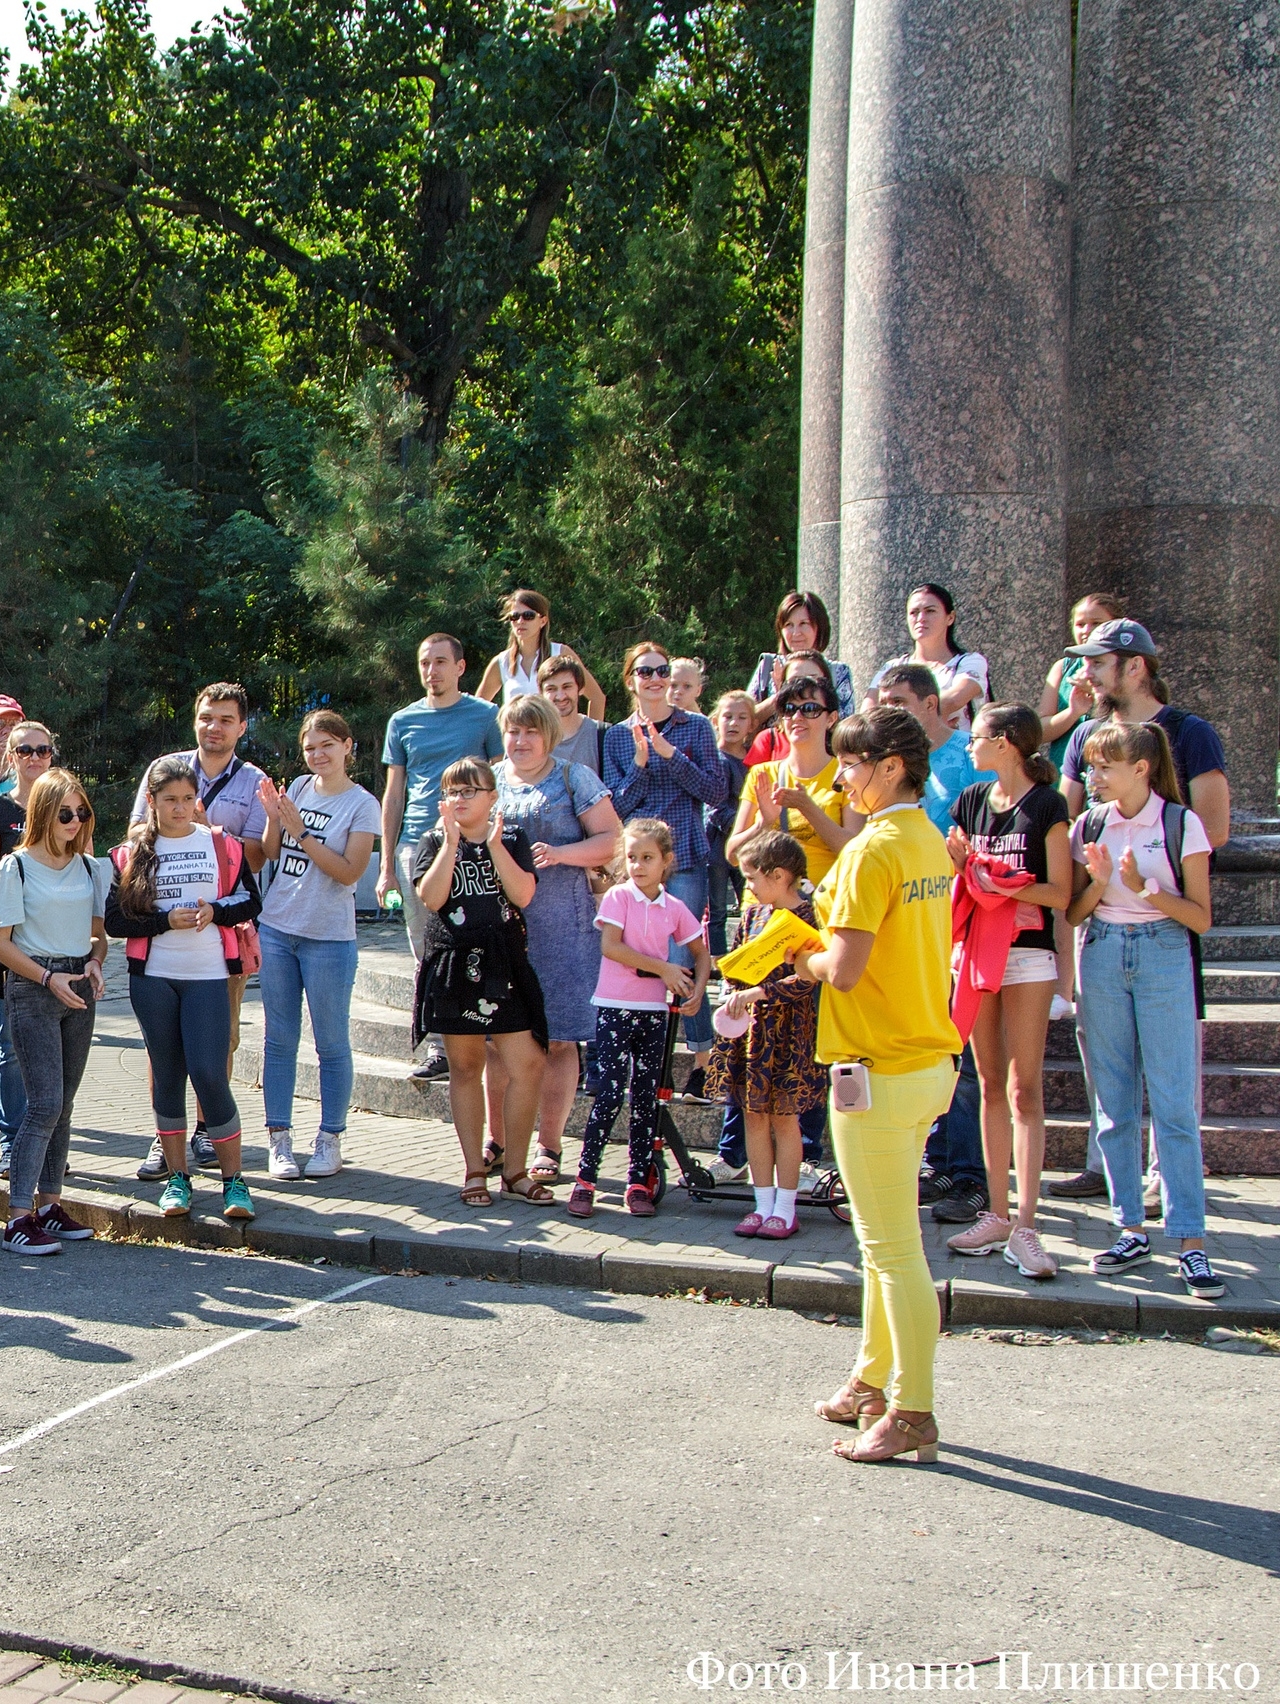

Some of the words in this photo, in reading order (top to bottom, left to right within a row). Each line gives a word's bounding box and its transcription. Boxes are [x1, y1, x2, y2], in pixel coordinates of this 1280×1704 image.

[167, 853, 187, 861] YORK
[285, 857, 306, 875] NO
[190, 872, 214, 882] ISLAND
